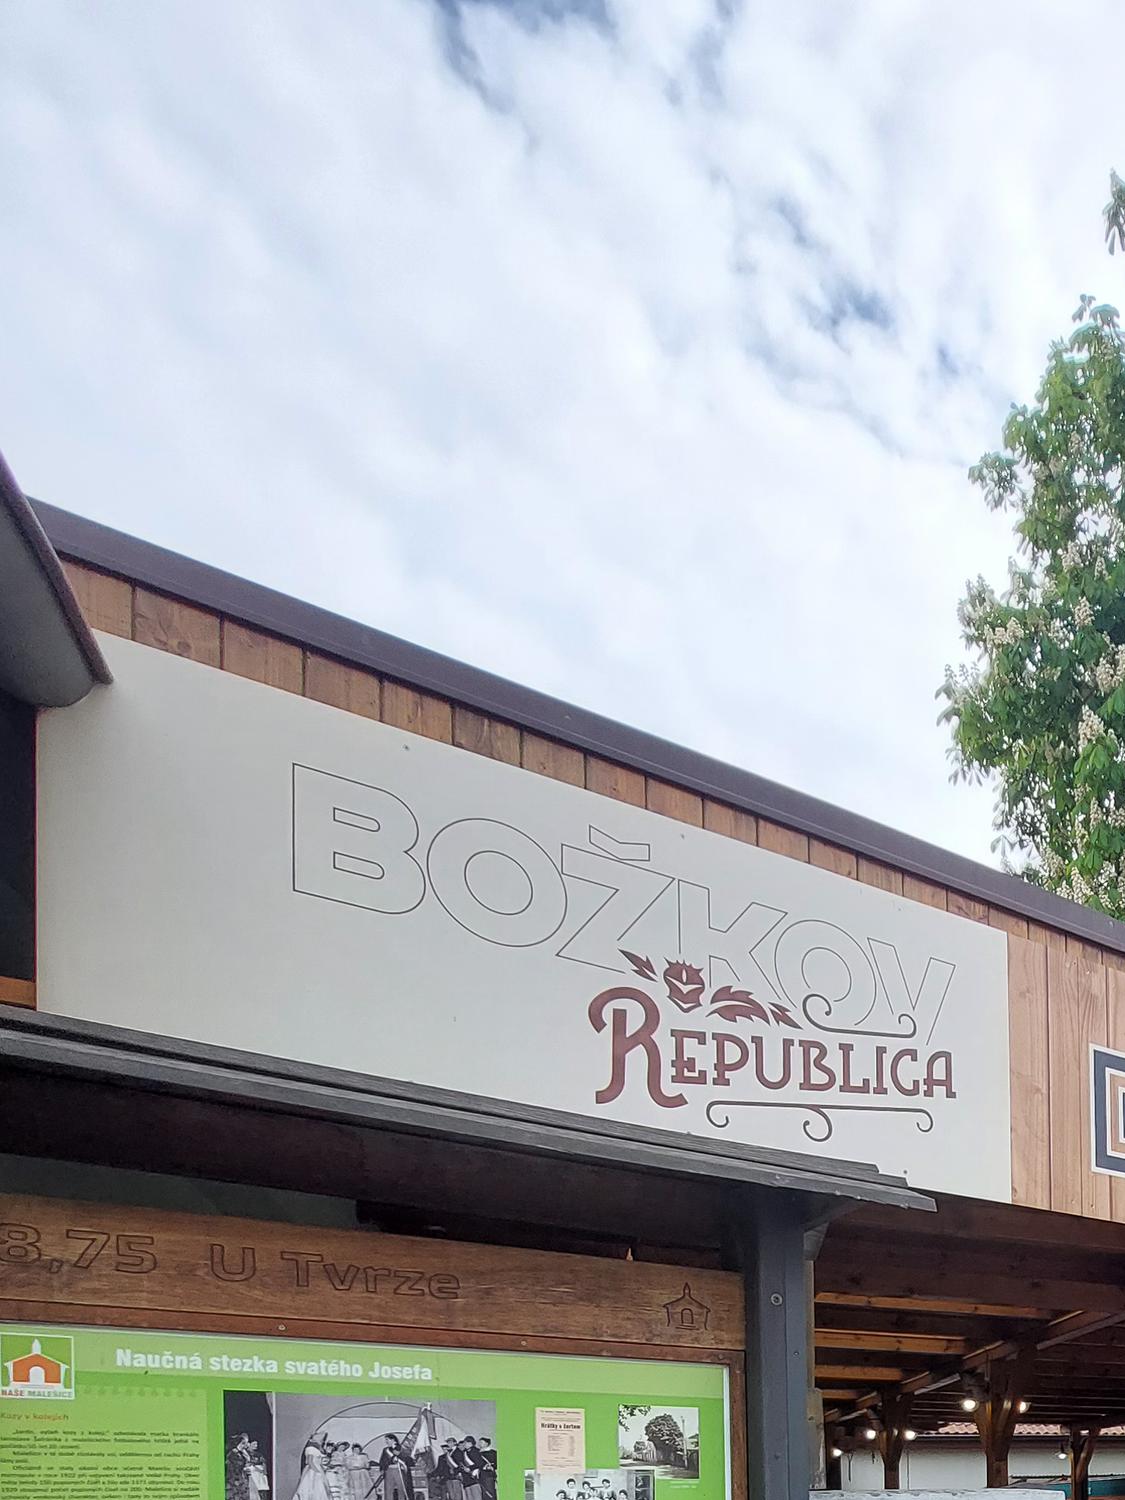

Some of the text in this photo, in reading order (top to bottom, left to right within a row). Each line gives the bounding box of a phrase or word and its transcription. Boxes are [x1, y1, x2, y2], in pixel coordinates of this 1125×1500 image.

[292, 762, 957, 1046] BOŽKOV
[588, 985, 958, 1110] REPUBLICA
[209, 1243, 256, 1283] U
[281, 1251, 461, 1301] Tvrze
[115, 1348, 433, 1382] Naučná stezka svatého Josefa
